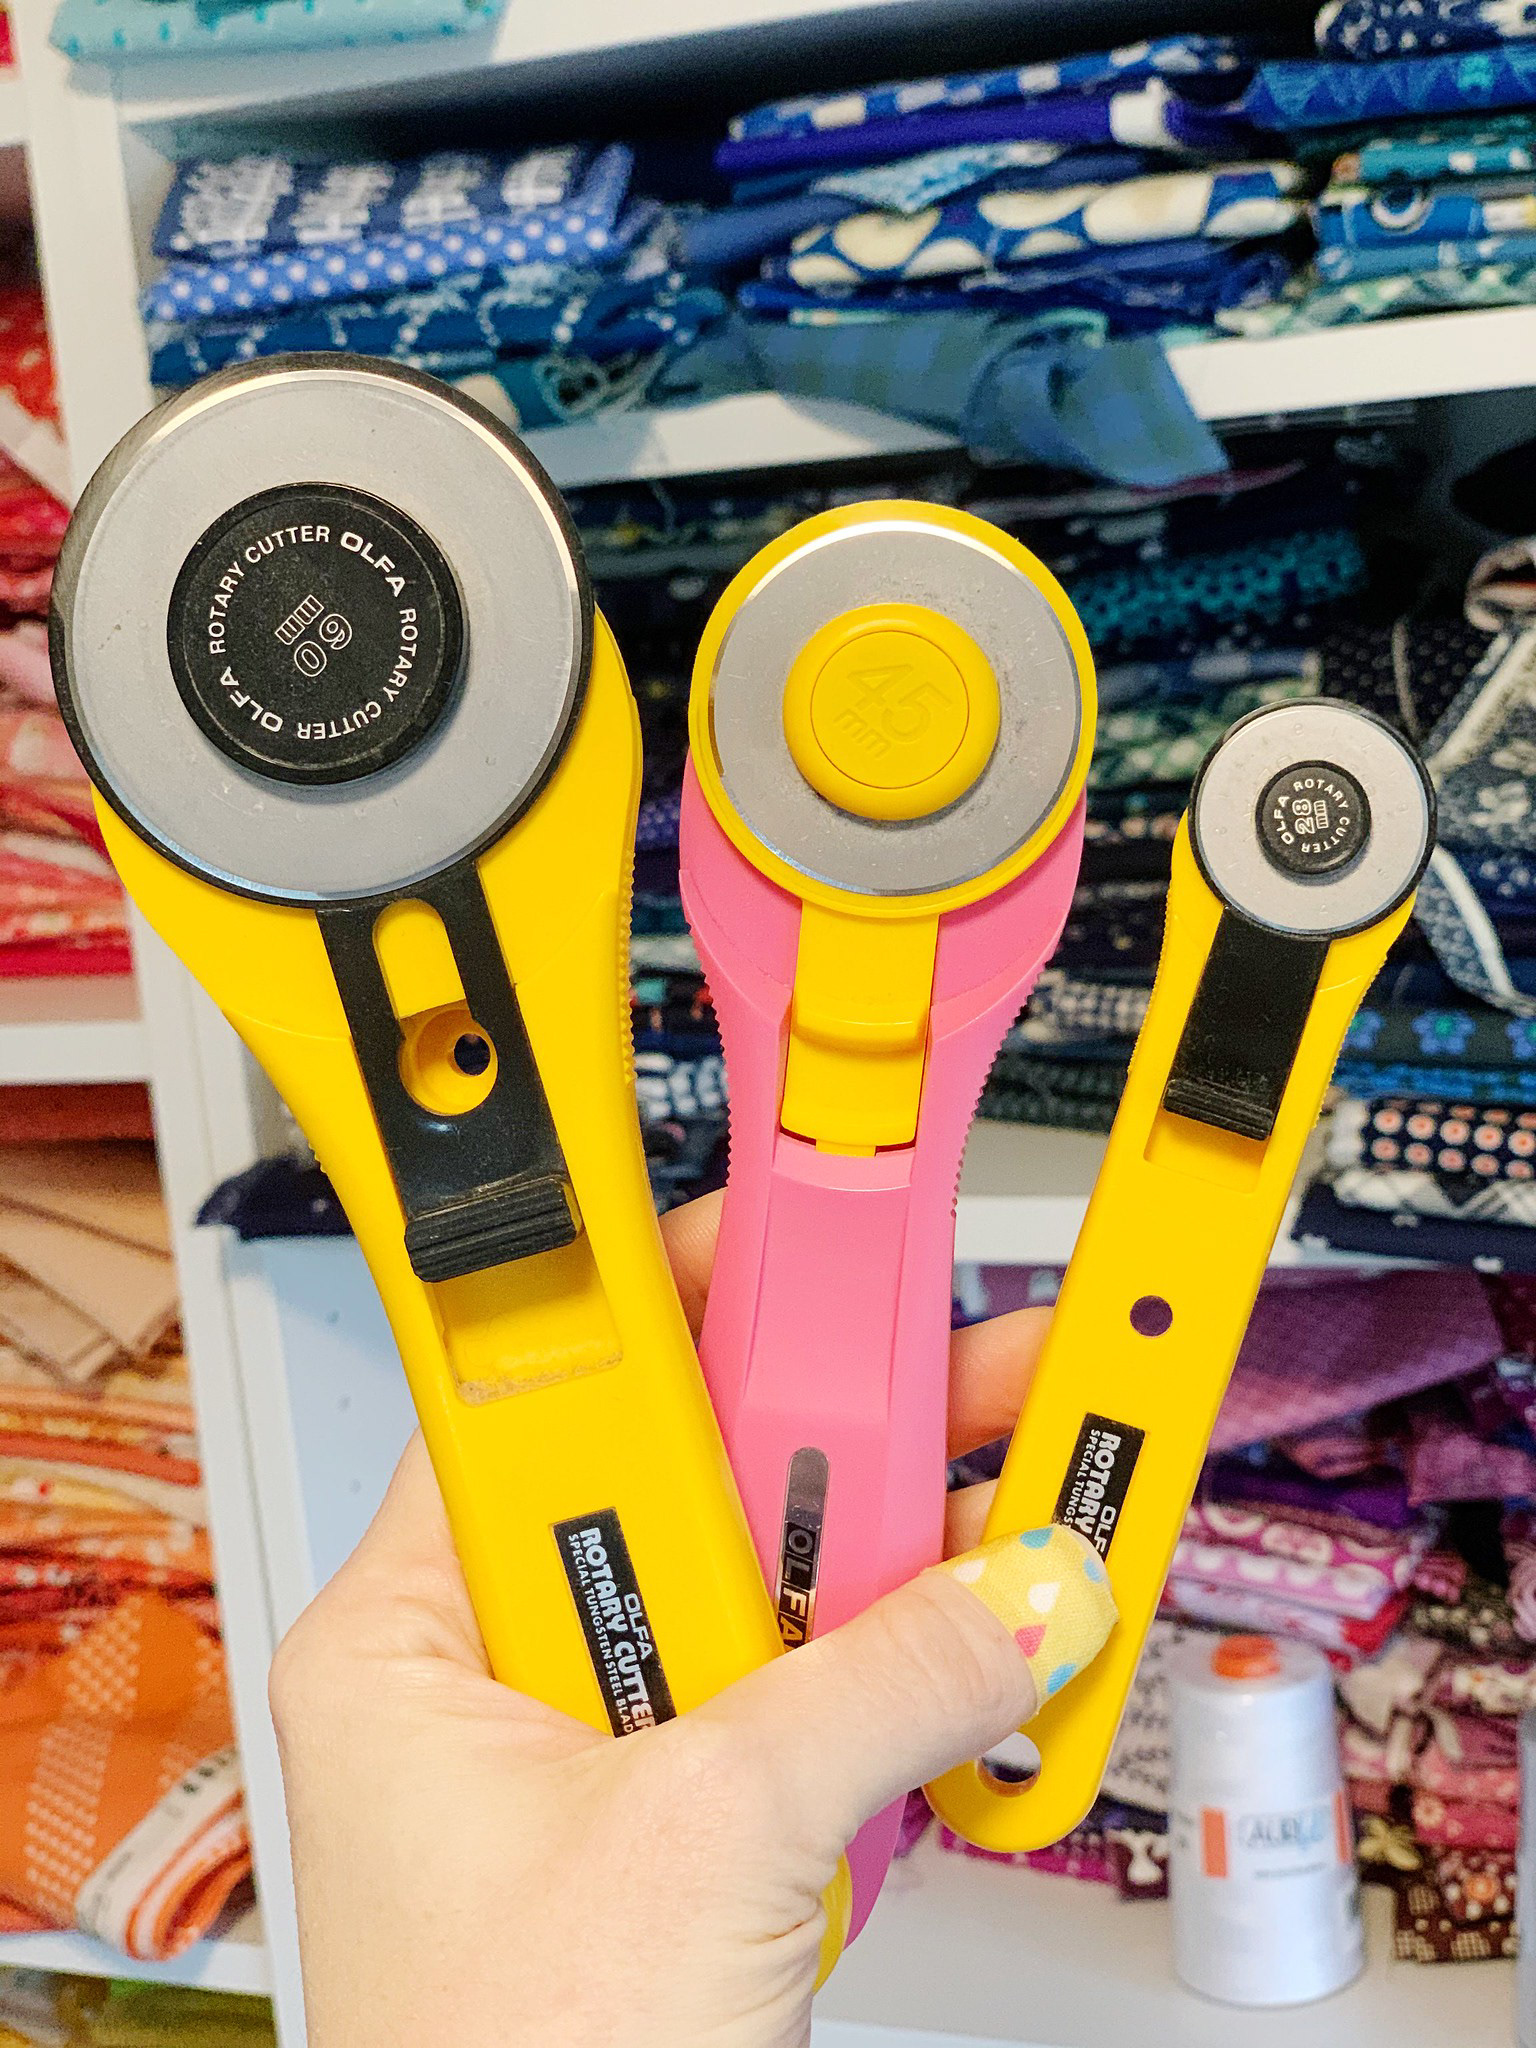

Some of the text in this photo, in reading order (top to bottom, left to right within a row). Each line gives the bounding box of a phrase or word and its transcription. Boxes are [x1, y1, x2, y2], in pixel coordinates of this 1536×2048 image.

[208, 525, 419, 740] ROTARY CUTTER OLFA ROTARY CUTTER OLFA
[294, 613, 353, 677] 60
[833, 708, 892, 760] mm
[846, 663, 953, 743] 45
[1273, 778, 1351, 853] OLFA ROTARY CUTTER
[1292, 799, 1316, 835] 28
[1063, 1429, 1101, 1529] SPECIAL TUNGS
[1075, 1431, 1122, 1535] ROTARY
[568, 1534, 591, 1587] SPECIAL
[584, 1587, 614, 1660] TUNGSTEN
[605, 1661, 624, 1697] STEEL
[579, 1527, 629, 1632] ROTARY
[780, 1528, 814, 1641] OLFA
[624, 1593, 653, 1660] OLFA
